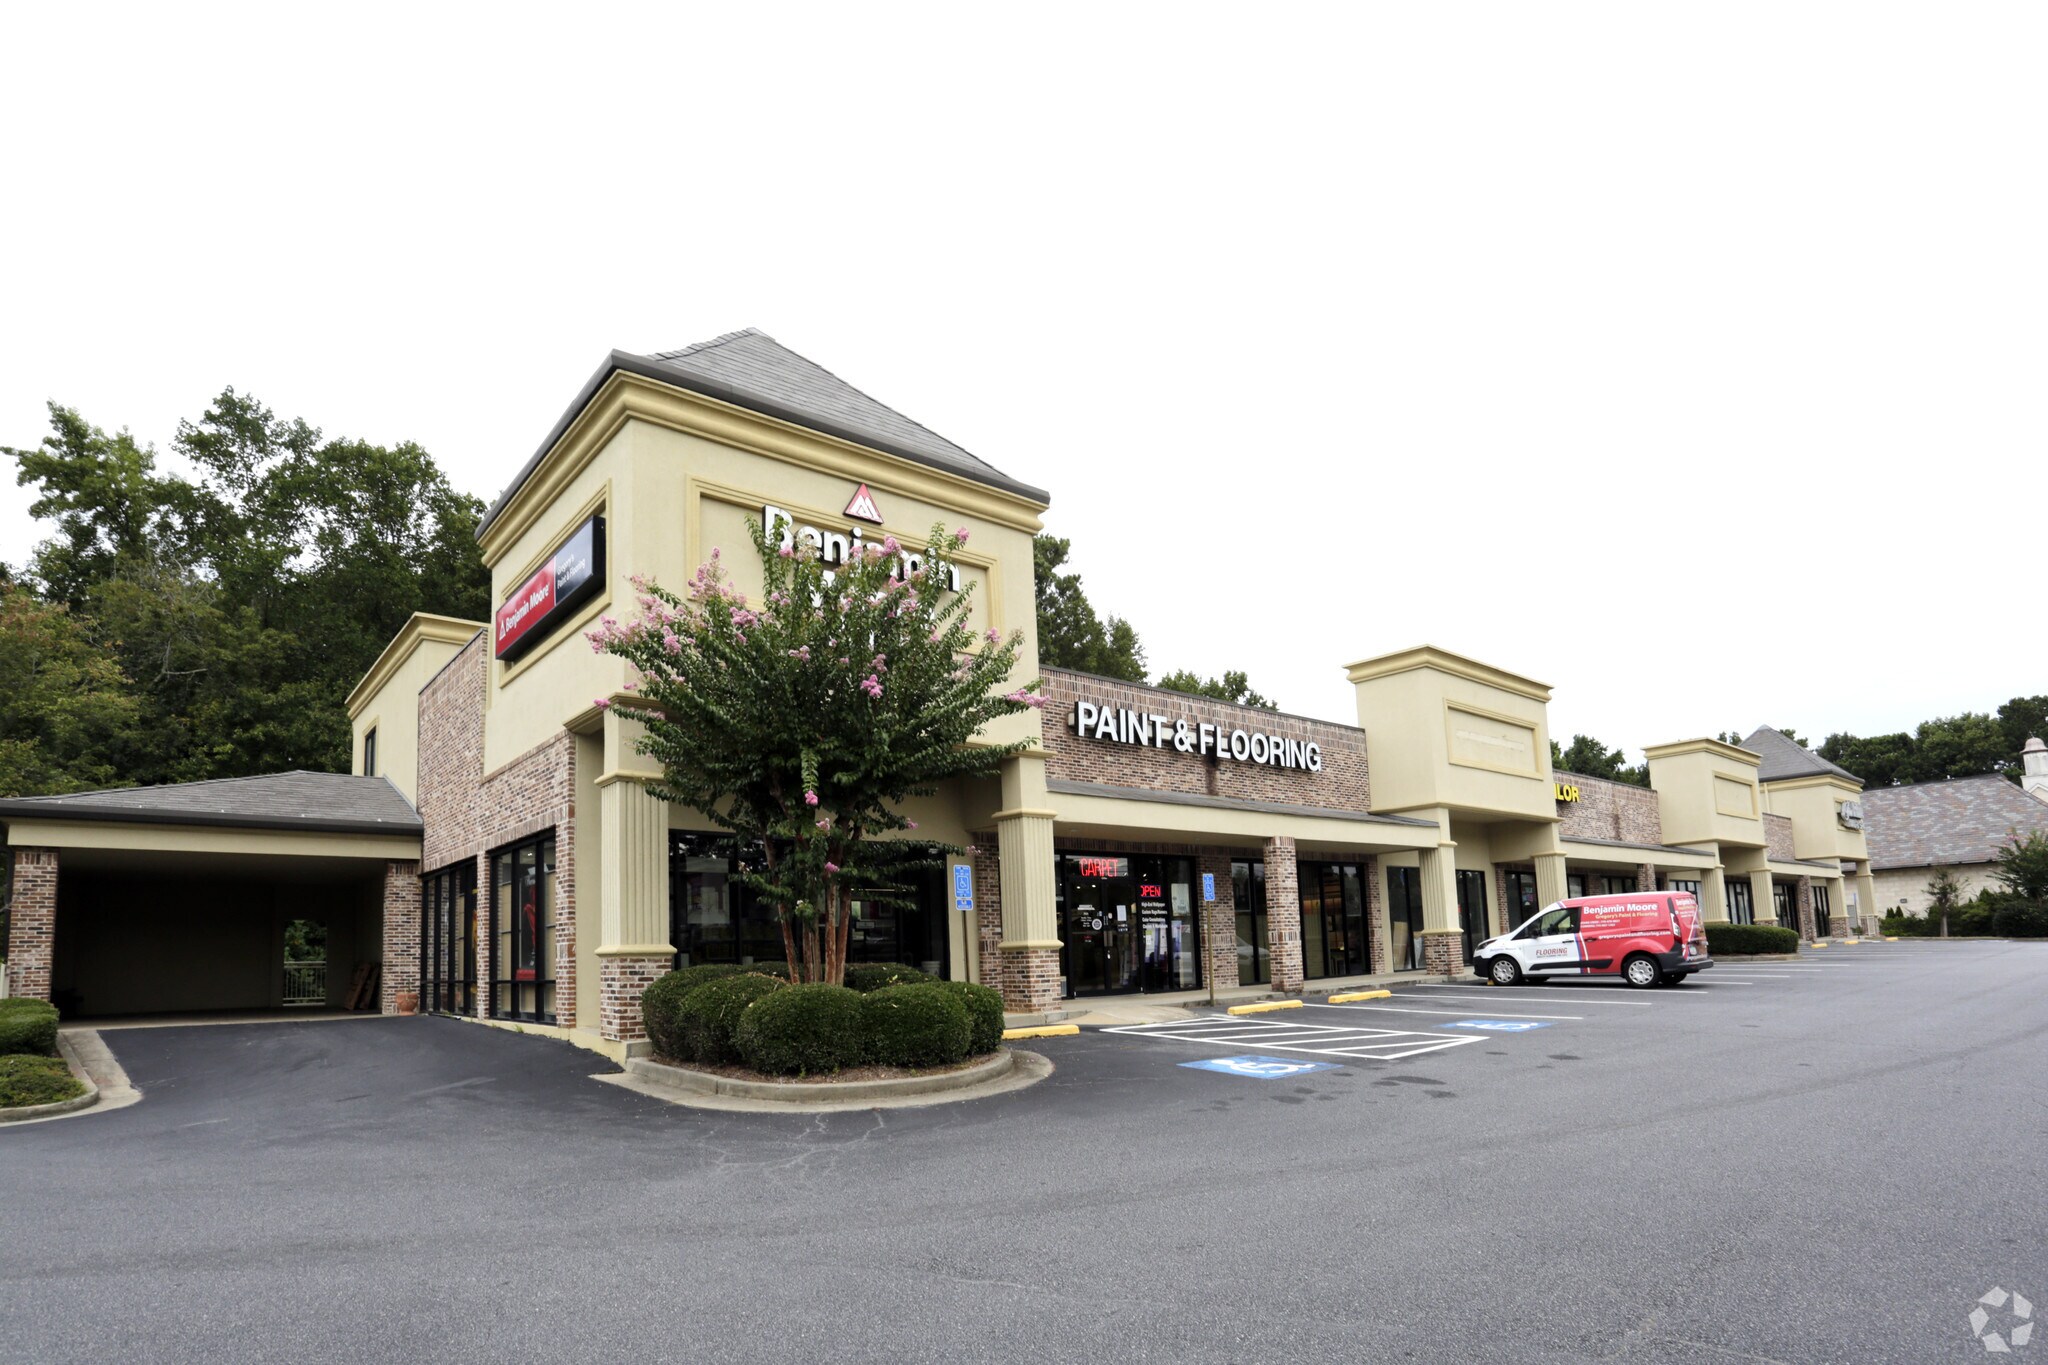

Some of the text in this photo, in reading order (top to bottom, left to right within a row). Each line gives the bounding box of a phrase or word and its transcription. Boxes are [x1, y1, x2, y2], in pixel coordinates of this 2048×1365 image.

[505, 586, 550, 633] Benjamin Moore
[1076, 701, 1322, 772] PAINT & FLOORING
[1080, 858, 1118, 877] CARPET
[1583, 903, 1658, 915] Benjamin Moore
[1536, 947, 1568, 956] FLOORING
